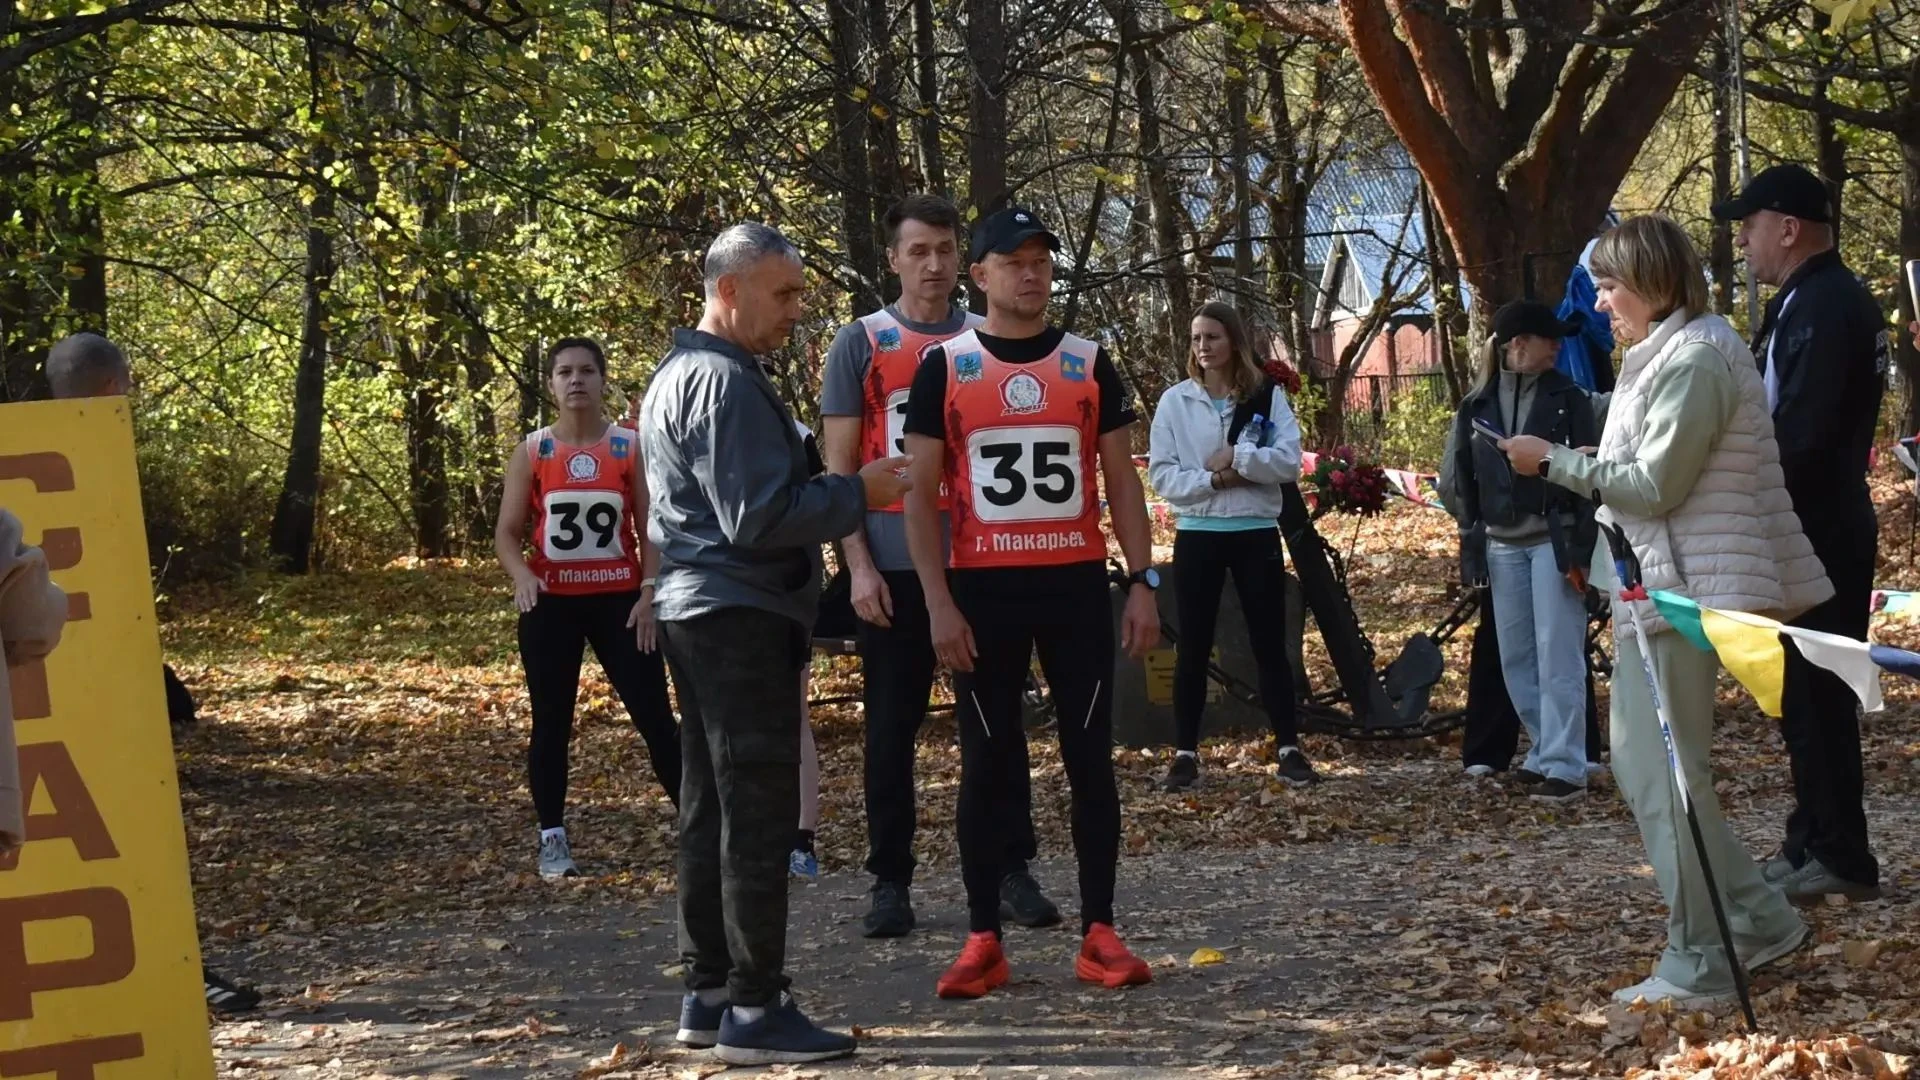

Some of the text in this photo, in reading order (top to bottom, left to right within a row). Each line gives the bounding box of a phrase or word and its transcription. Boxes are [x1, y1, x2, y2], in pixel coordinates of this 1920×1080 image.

[980, 442, 1075, 506] 35
[550, 502, 618, 550] 39
[976, 531, 1086, 552] г. Макарьев
[545, 567, 631, 583] г. Макарьев
